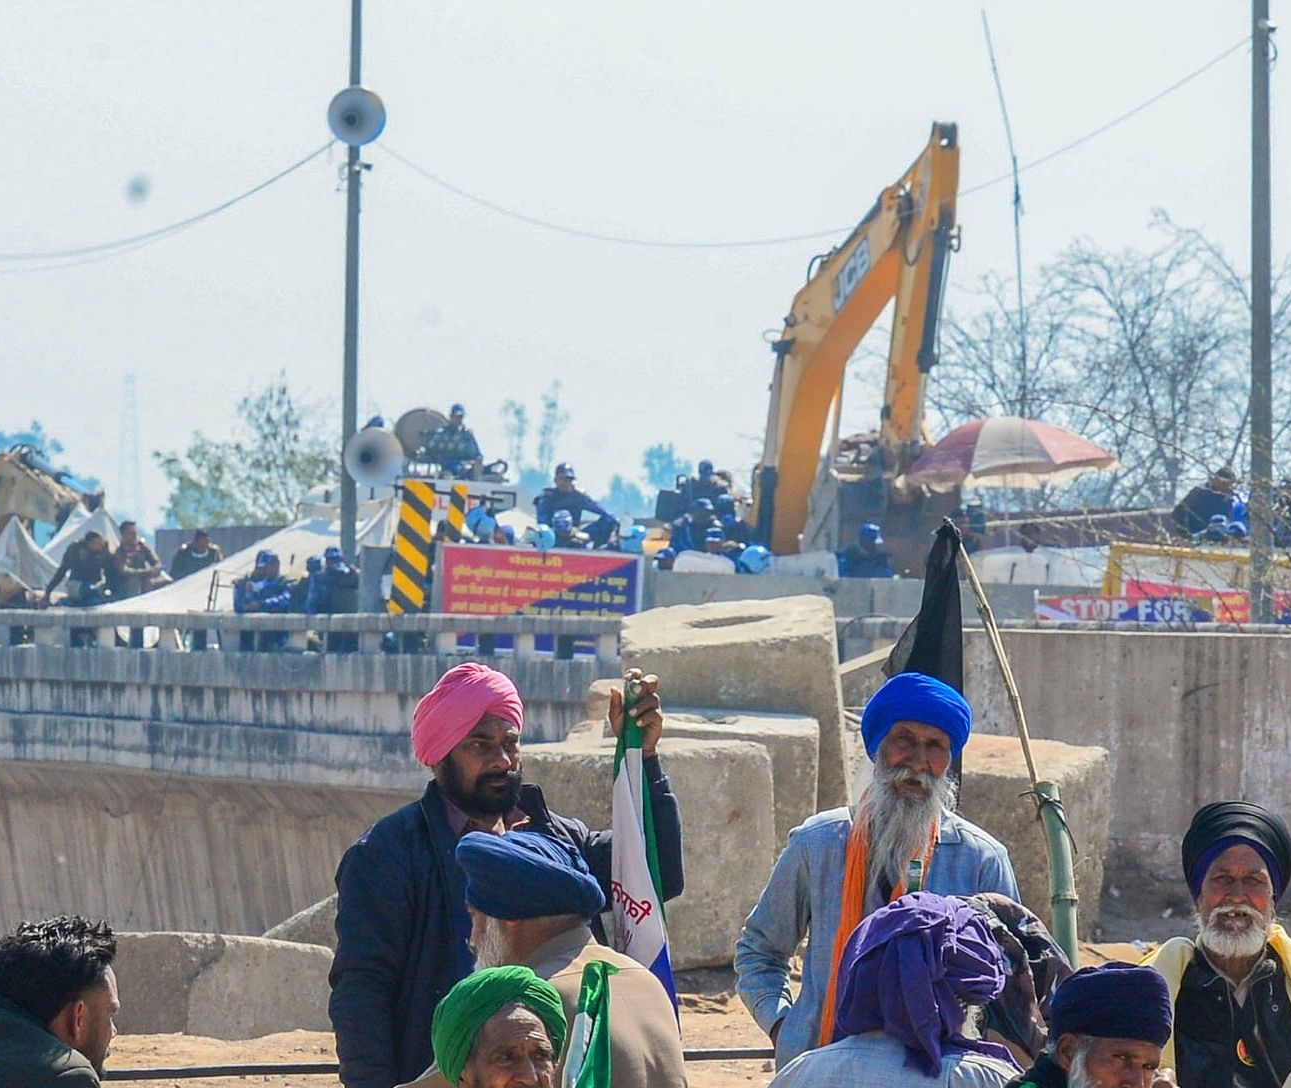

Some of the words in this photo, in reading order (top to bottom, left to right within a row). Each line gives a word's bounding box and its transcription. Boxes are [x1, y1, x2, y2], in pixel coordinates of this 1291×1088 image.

[834, 244, 870, 305] JCB
[1060, 599, 1129, 620] STOP
[1138, 600, 1190, 621] FOR
